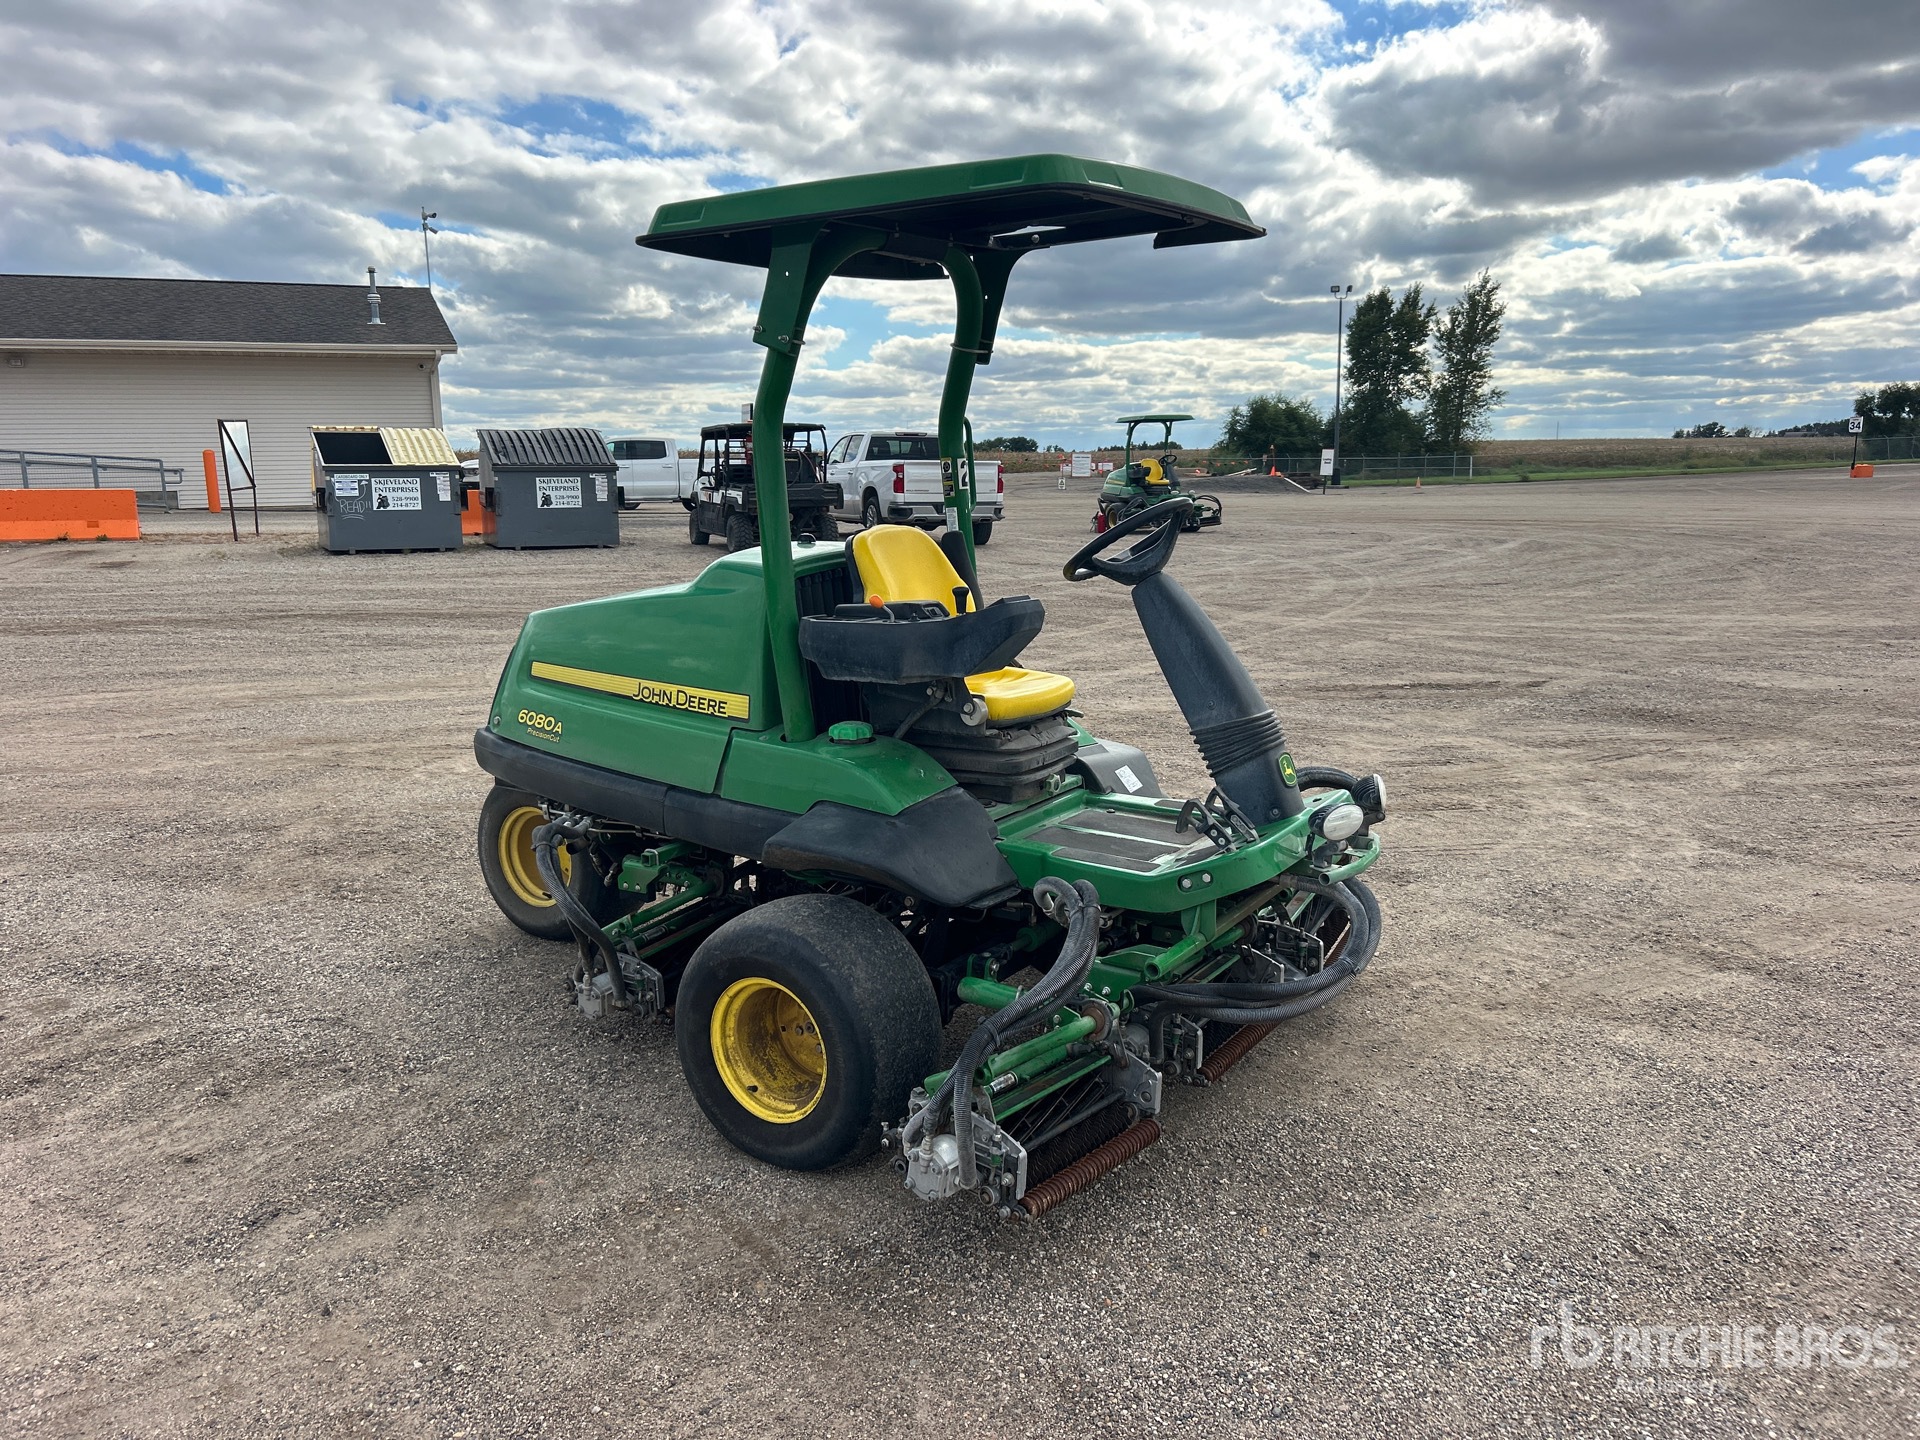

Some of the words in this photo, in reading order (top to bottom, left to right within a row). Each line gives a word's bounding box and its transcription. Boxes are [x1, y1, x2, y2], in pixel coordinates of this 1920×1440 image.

[1849, 421, 1861, 430] 34
[632, 682, 673, 704] JOHN
[676, 689, 728, 715] DEERE
[518, 709, 562, 735] 6080A
